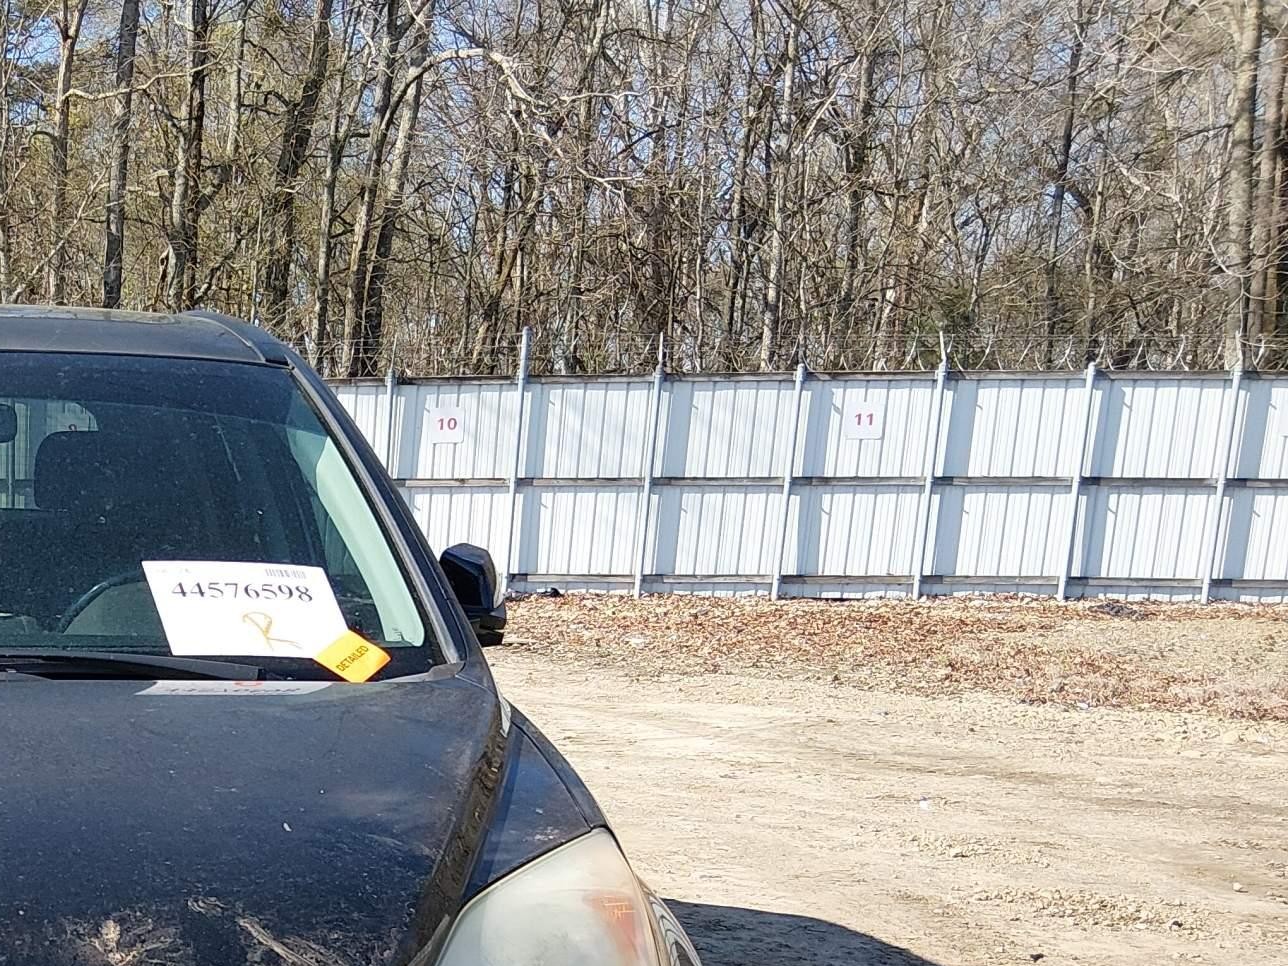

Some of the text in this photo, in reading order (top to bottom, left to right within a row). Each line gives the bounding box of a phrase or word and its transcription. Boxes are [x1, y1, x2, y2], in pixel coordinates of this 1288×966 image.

[437, 417, 458, 431] 10
[854, 412, 874, 426] 11
[171, 581, 313, 602] 44576598
[335, 645, 369, 672] DETAILED
